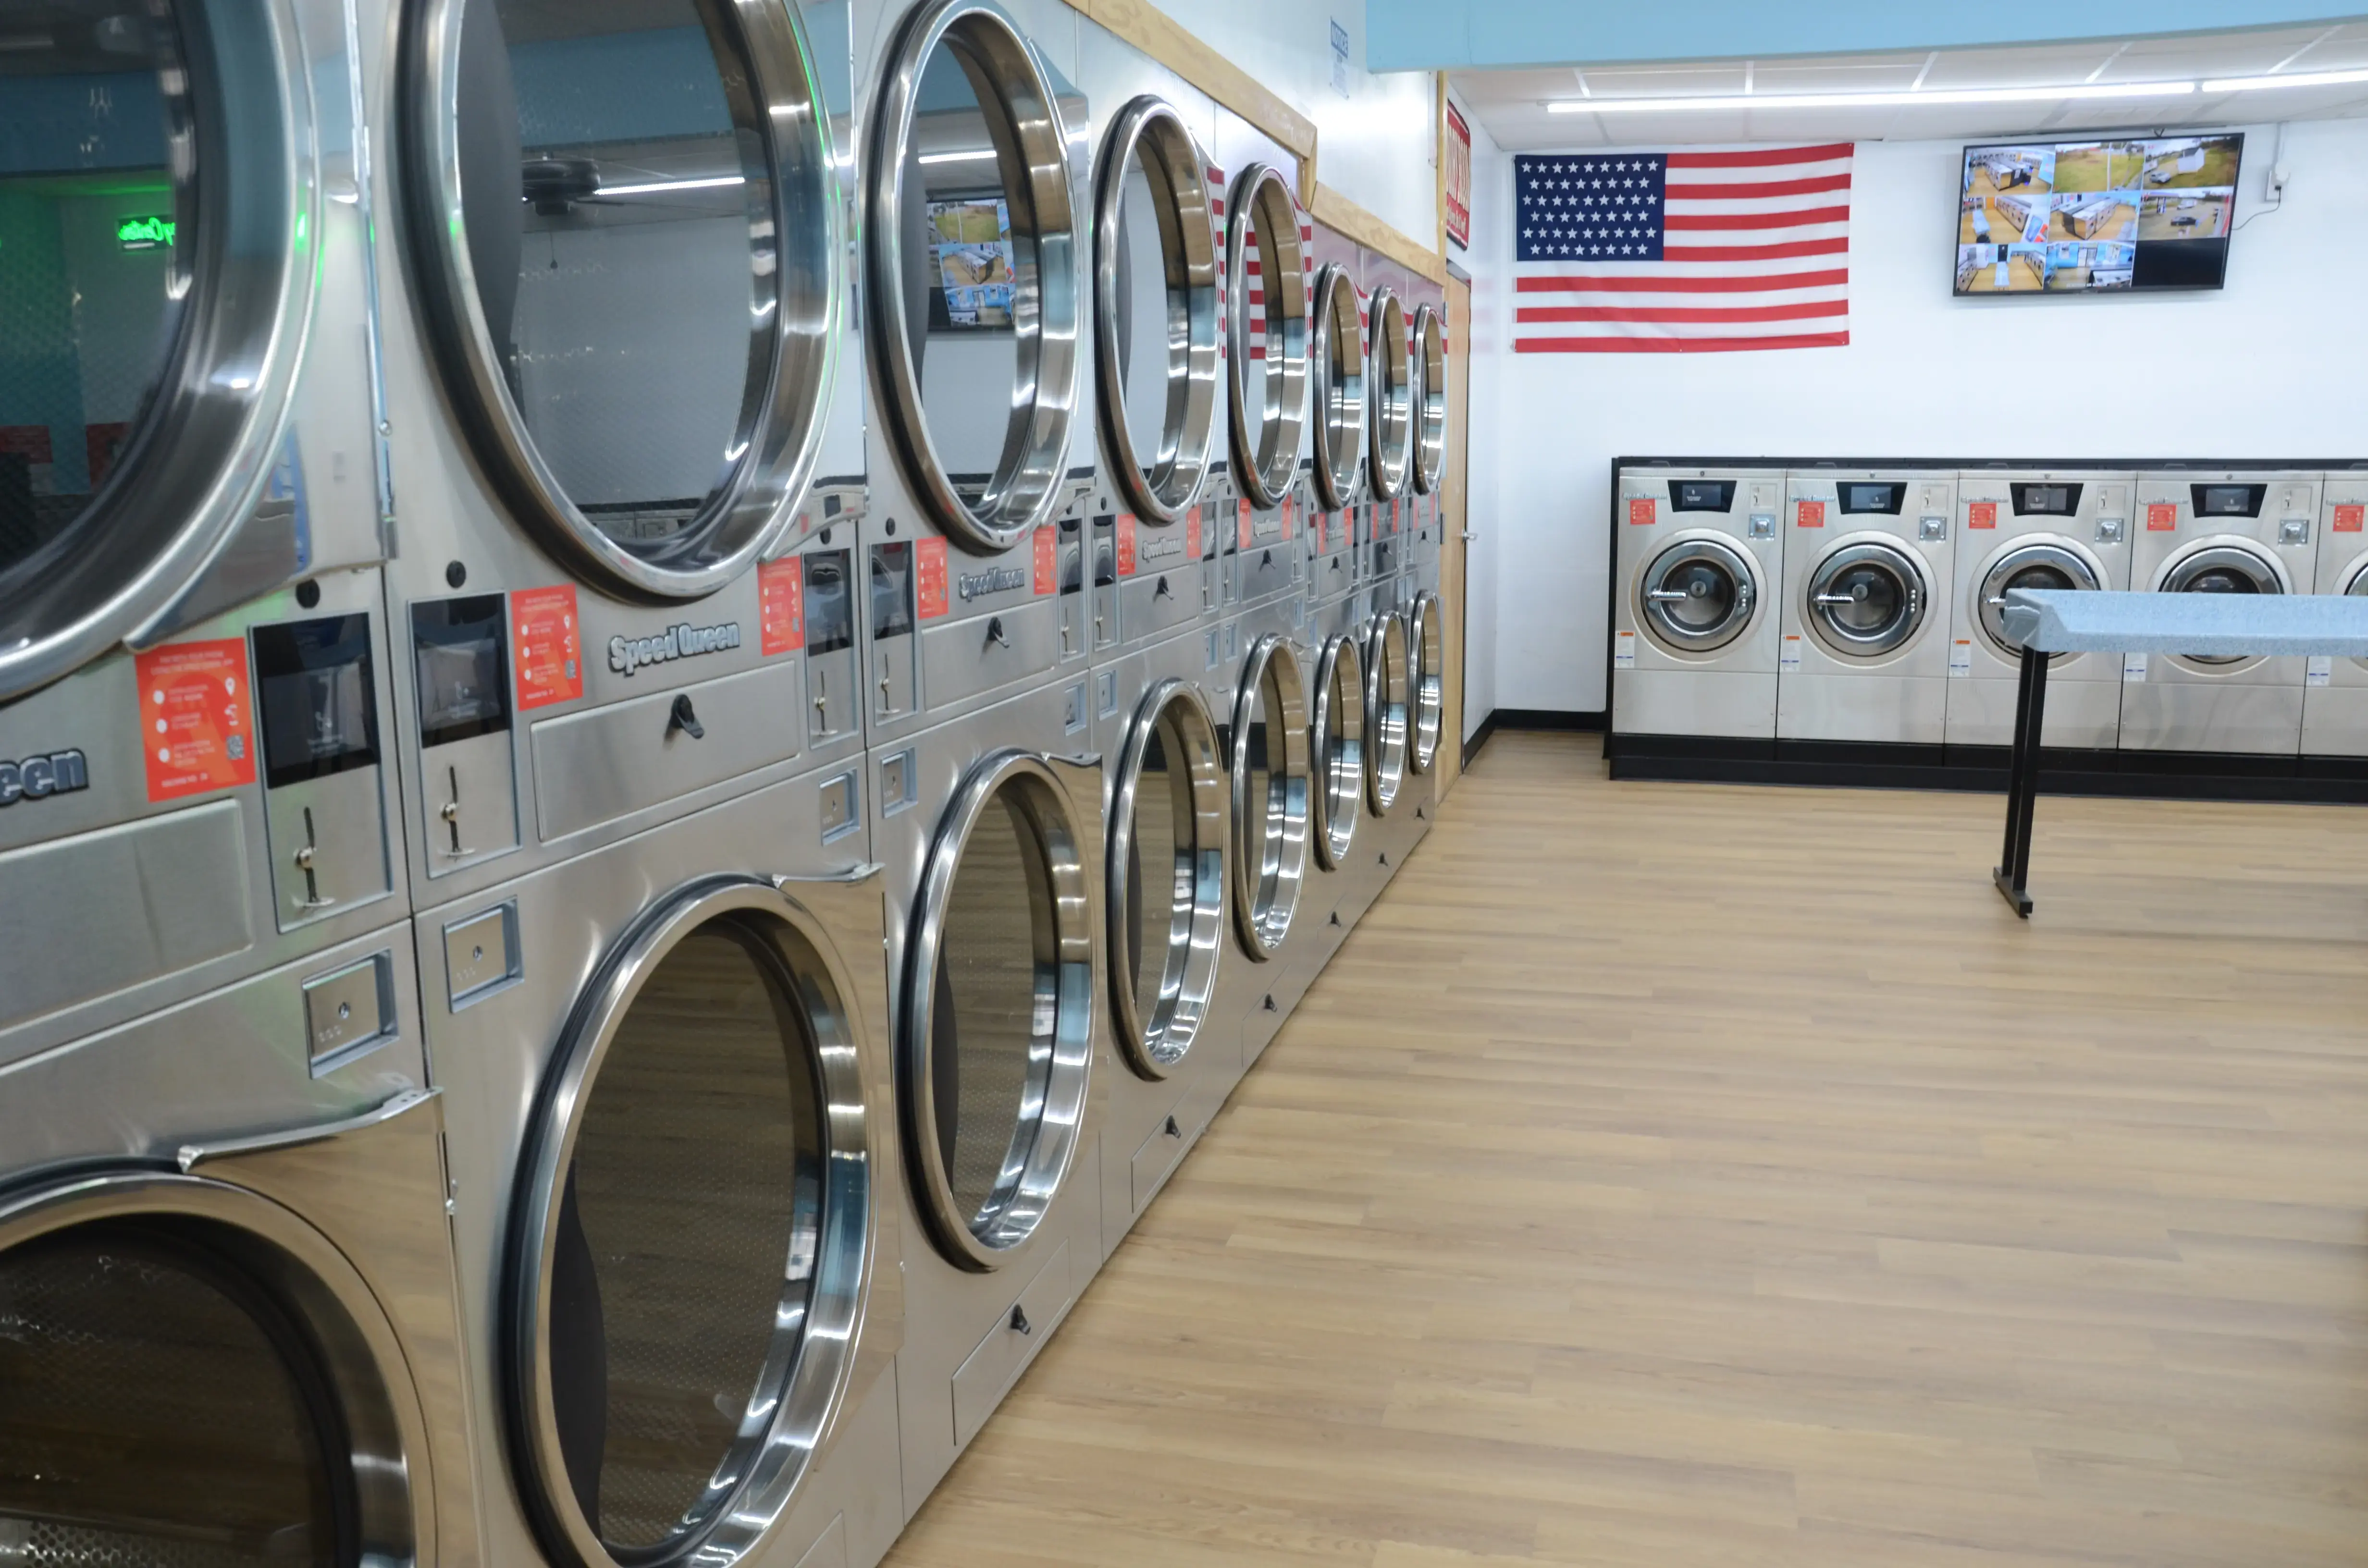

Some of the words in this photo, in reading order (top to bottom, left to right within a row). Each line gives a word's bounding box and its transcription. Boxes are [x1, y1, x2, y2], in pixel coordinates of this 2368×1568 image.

[1332, 24, 1348, 56] NOTICE
[608, 625, 678, 677] Speed
[678, 623, 740, 658] Queen
